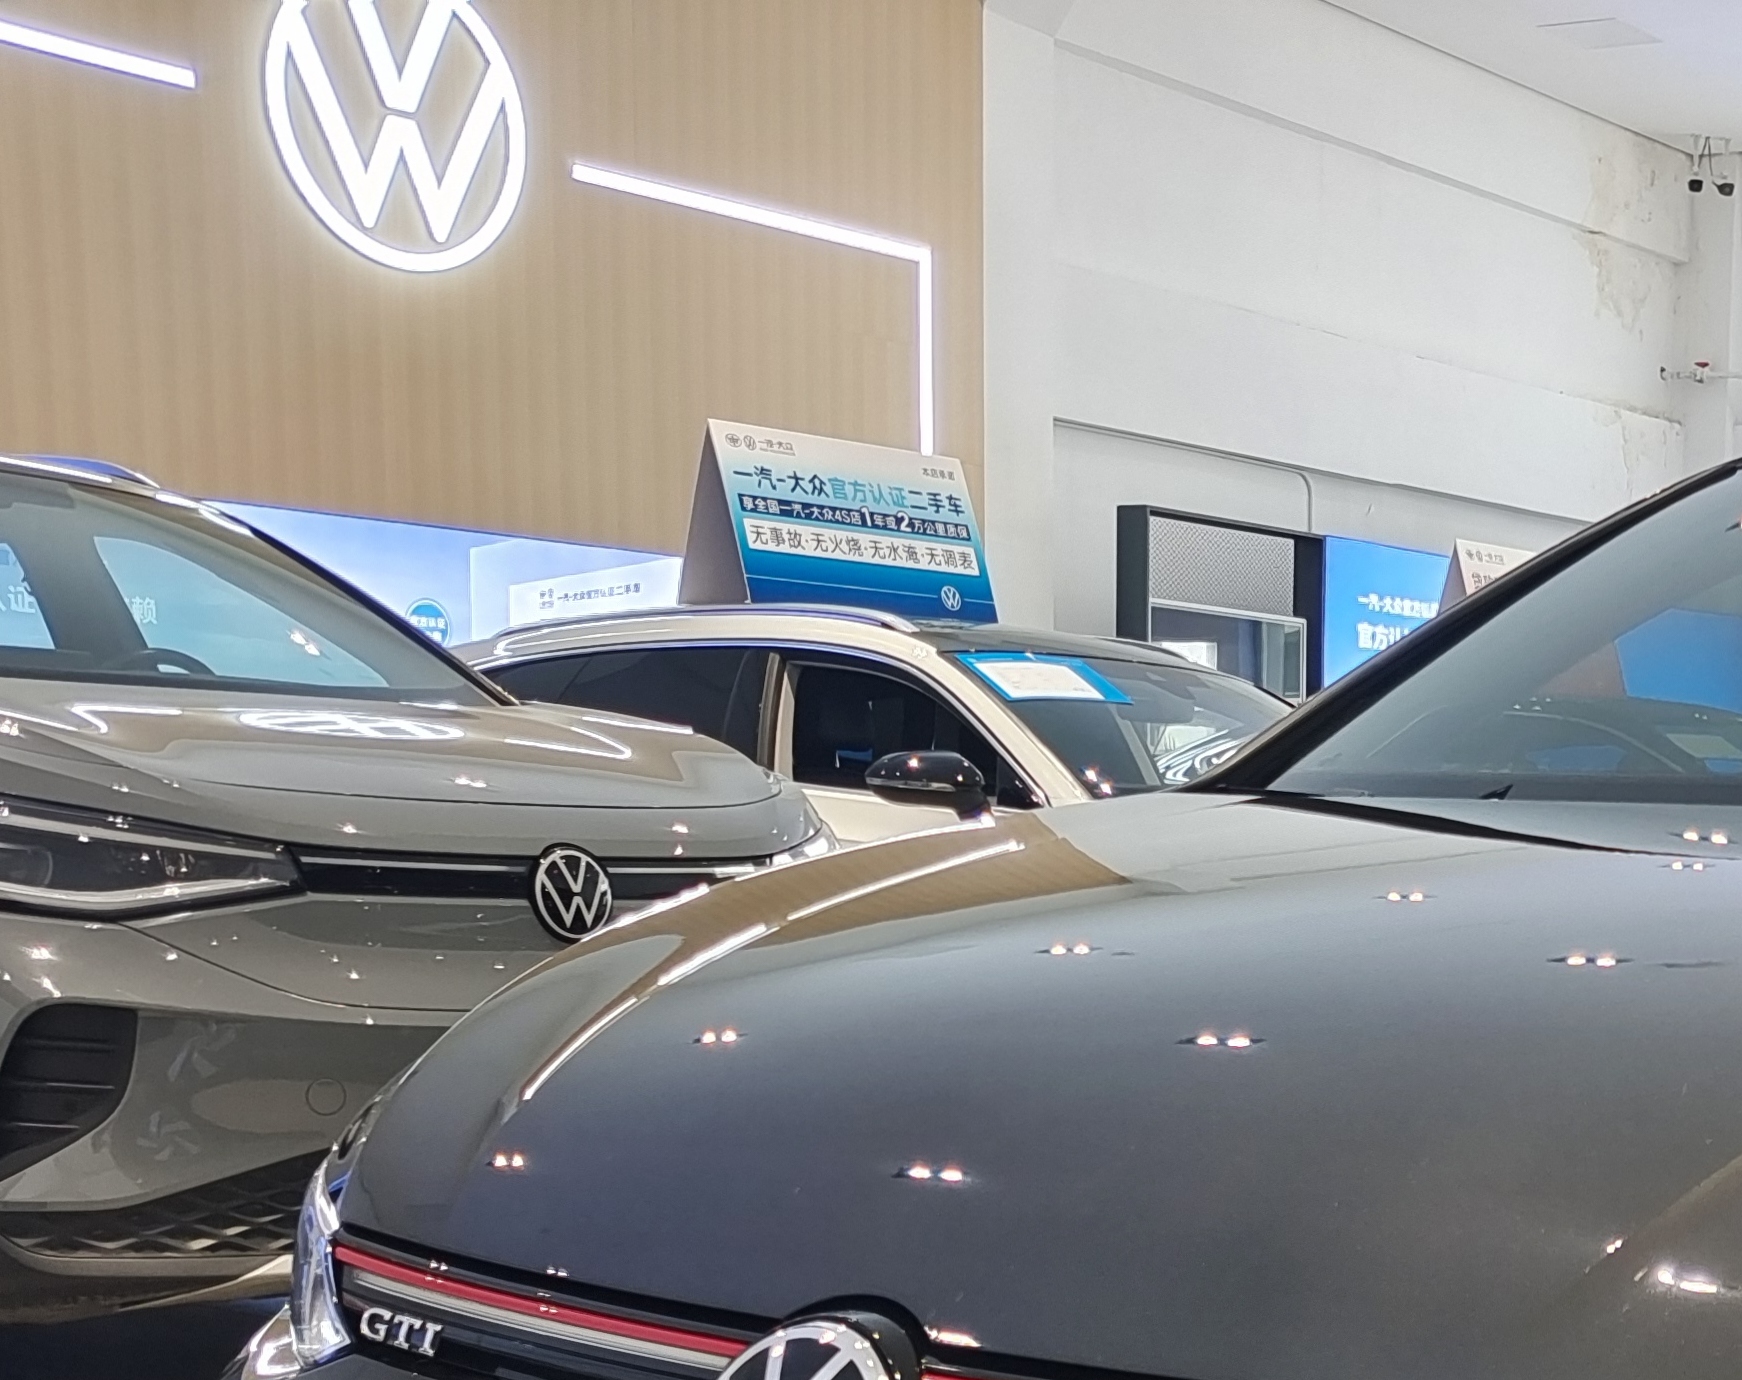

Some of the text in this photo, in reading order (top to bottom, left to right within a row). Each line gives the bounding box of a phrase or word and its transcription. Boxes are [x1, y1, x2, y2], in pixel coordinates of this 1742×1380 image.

[733, 465, 965, 517] 一汽-大众官方认证二手车
[360, 1307, 443, 1357] GTI
